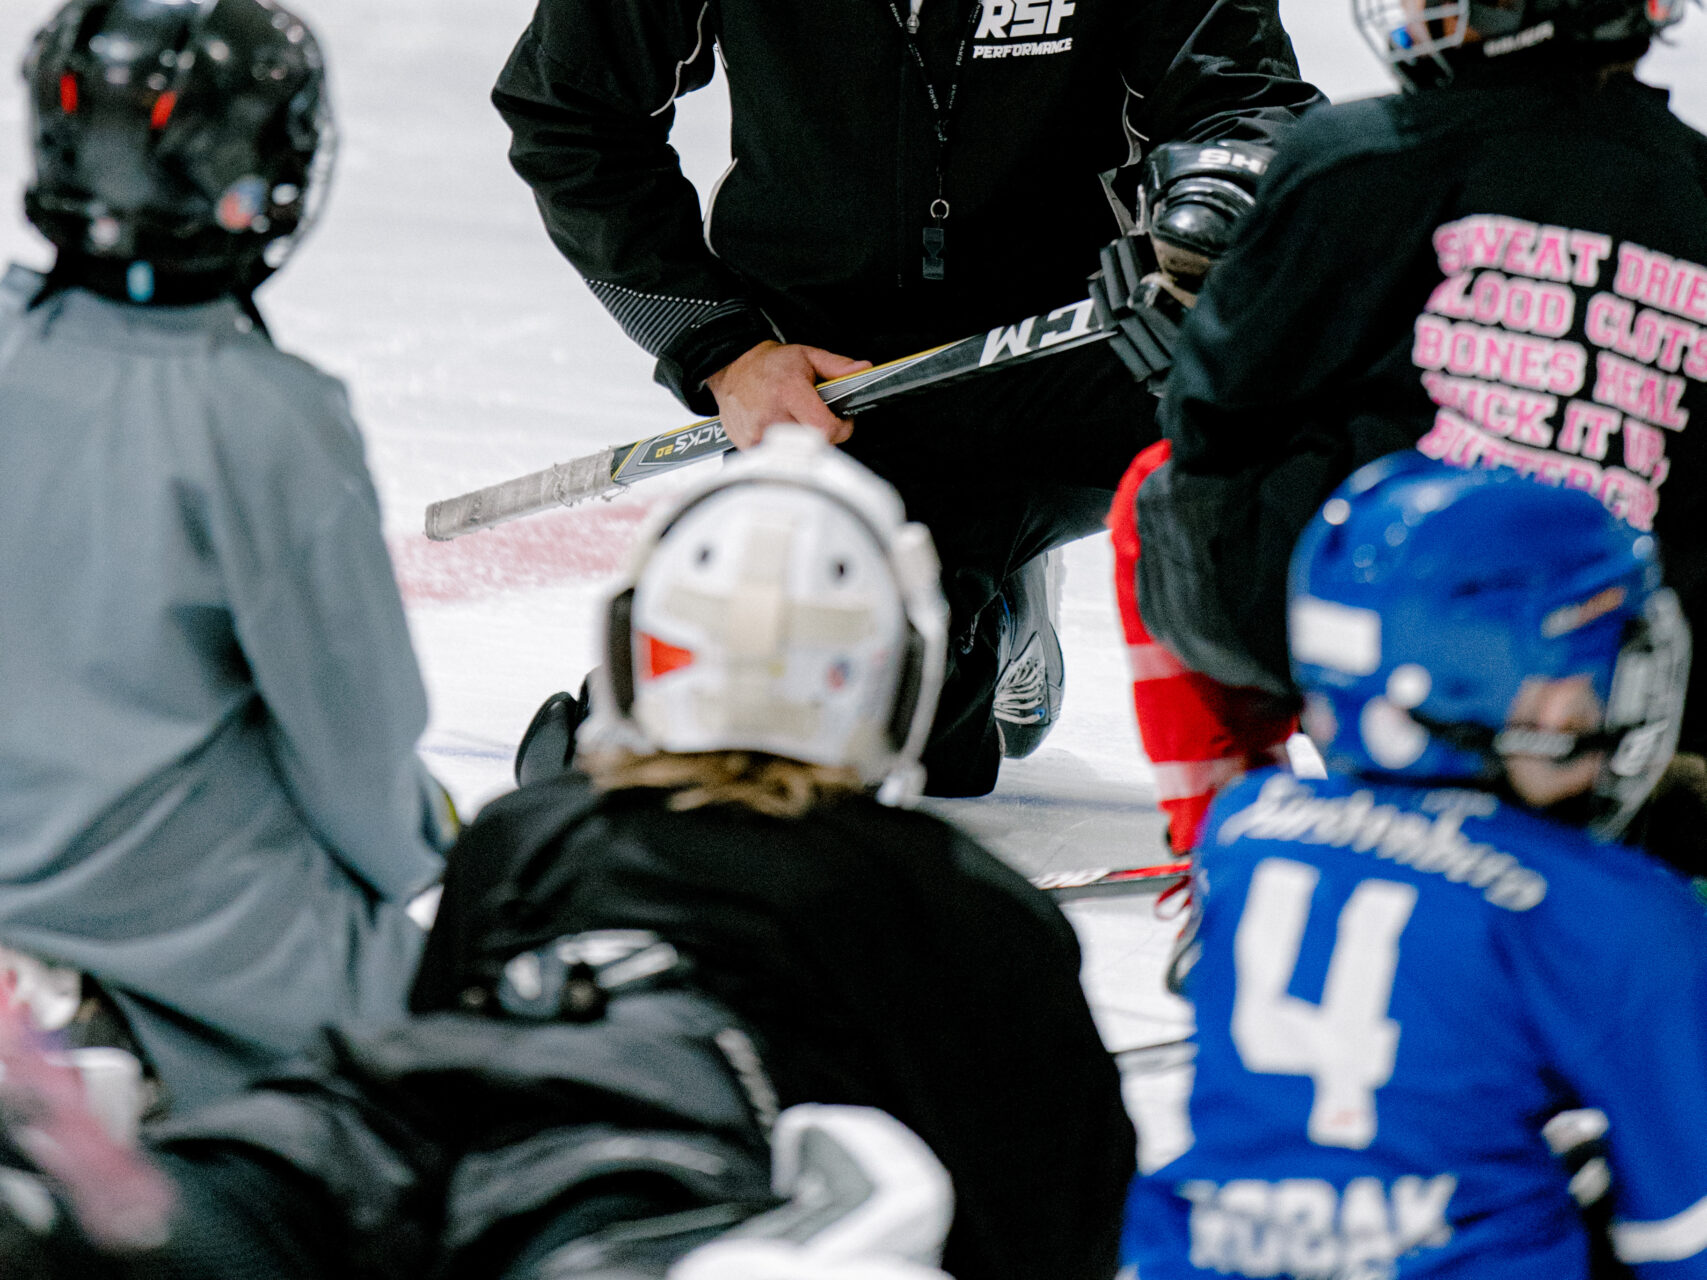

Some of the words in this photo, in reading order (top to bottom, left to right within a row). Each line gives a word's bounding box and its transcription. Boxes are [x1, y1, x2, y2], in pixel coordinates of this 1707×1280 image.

[972, 37, 1073, 59] PERFORMANCE
[1433, 214, 1612, 288] SWEAT
[979, 297, 1098, 367] CM
[1424, 270, 1576, 339] LOOD
[1584, 291, 1707, 383] CLOTS
[1412, 312, 1588, 397] BONES
[1592, 350, 1690, 433] HEAL
[1557, 398, 1623, 461] IT
[1230, 856, 1418, 1150] 4
